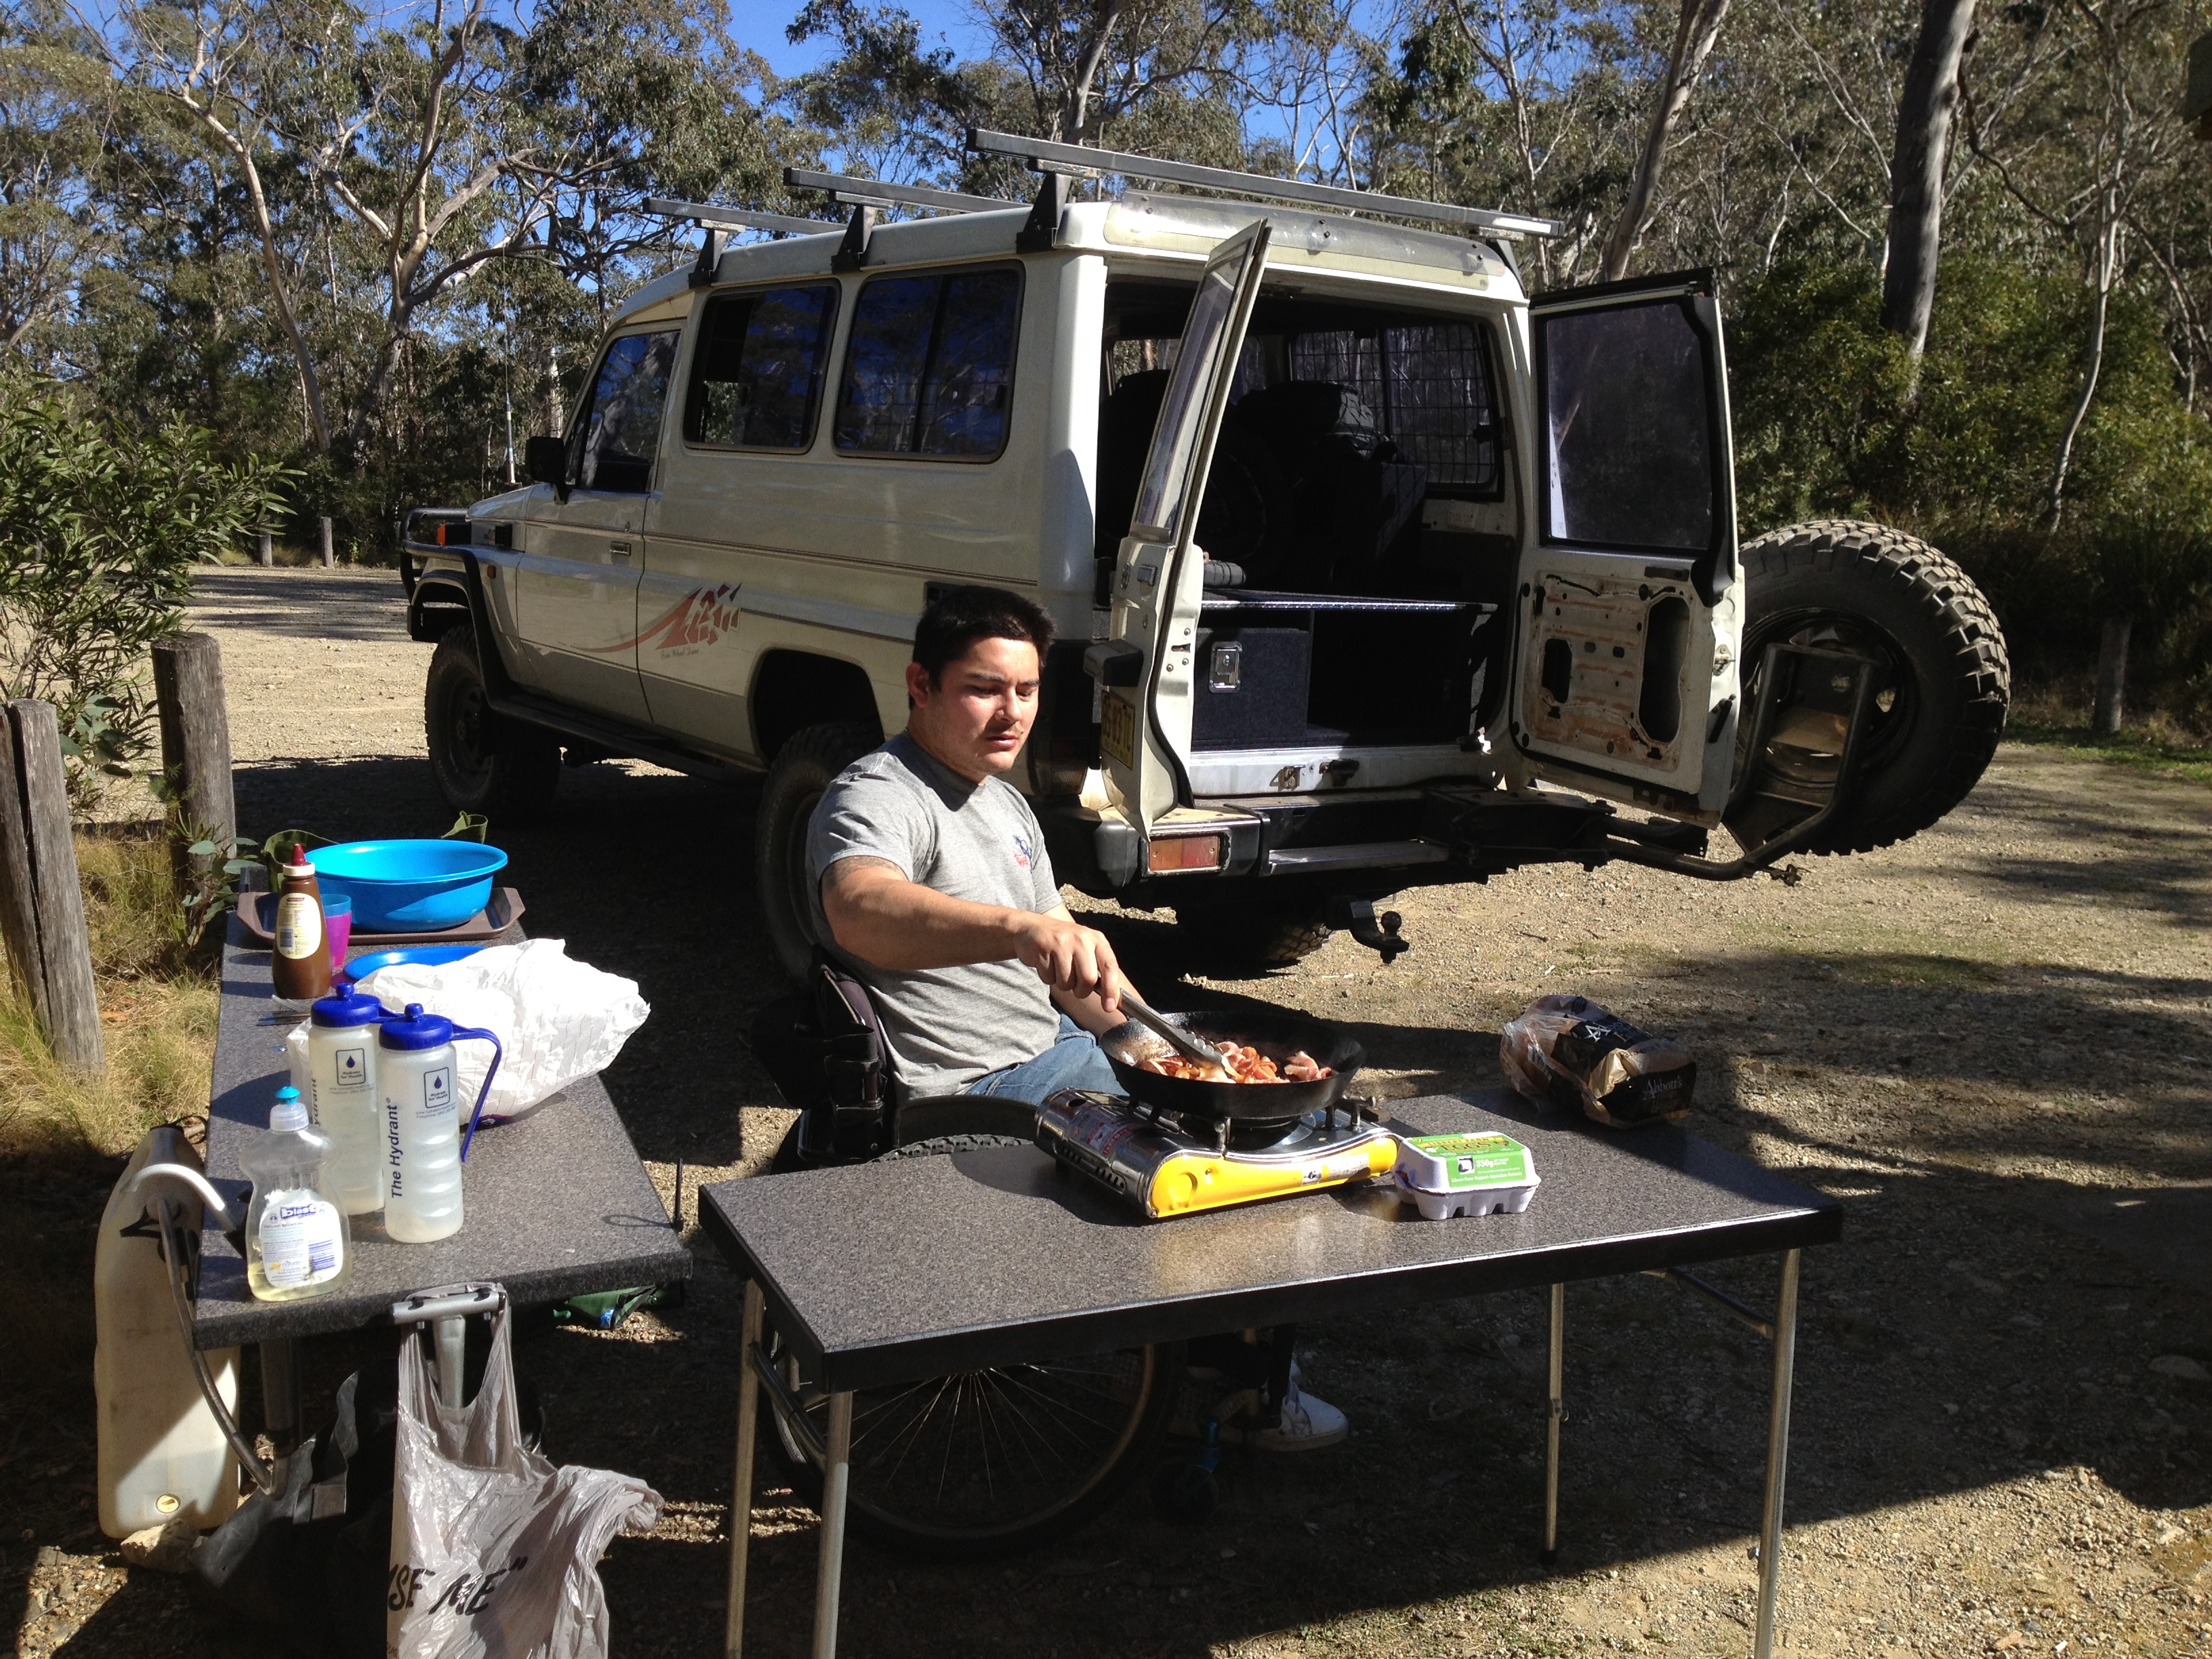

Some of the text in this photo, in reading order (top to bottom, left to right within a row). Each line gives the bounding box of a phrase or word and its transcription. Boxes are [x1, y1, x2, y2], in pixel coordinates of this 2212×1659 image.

[1440, 1141, 1492, 1151] EGGS
[1476, 1159, 1494, 1168] 350g
[392, 1170, 403, 1198] The
